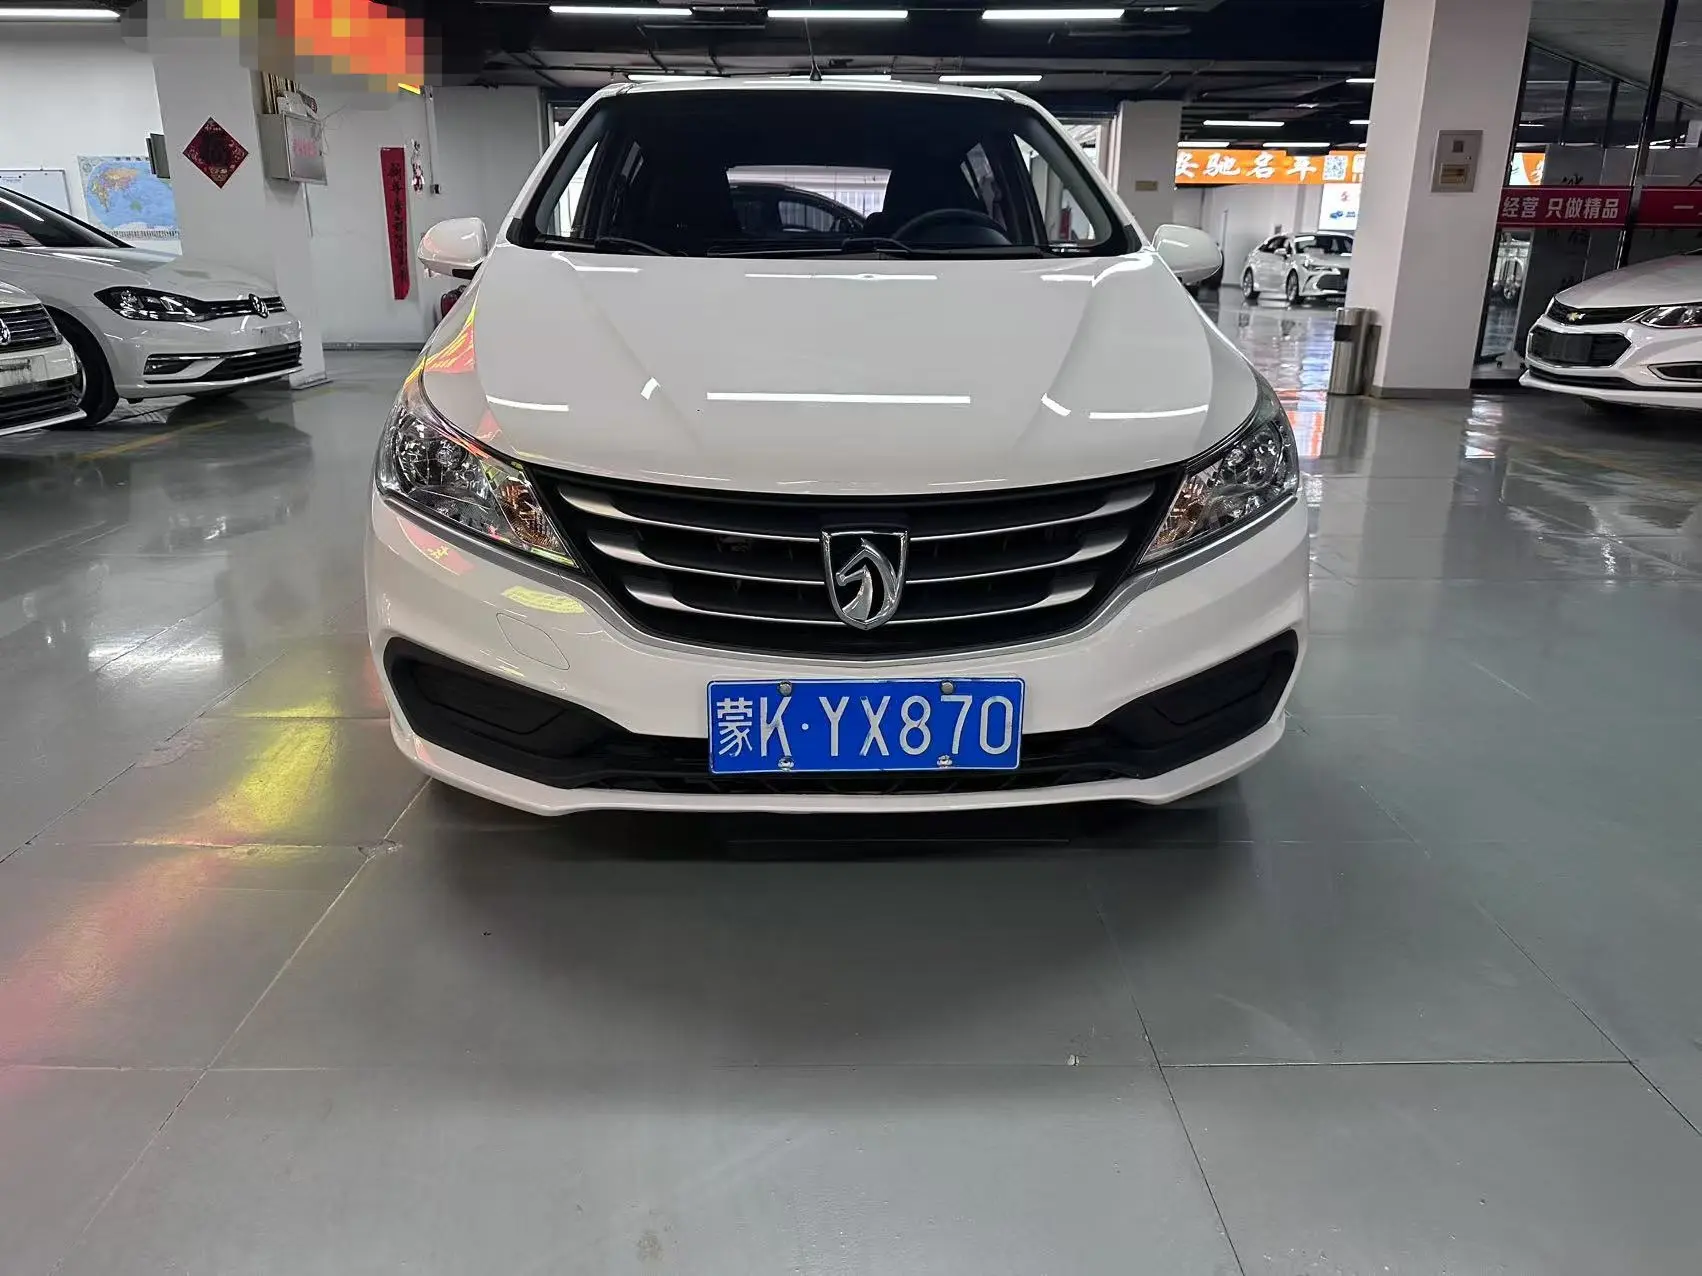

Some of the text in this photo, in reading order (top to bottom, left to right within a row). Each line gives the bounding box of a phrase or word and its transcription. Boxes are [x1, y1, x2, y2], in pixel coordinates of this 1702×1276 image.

[1502, 196, 1620, 219] 经营 只做精品
[716, 694, 1014, 757] 蒙K·YX870
